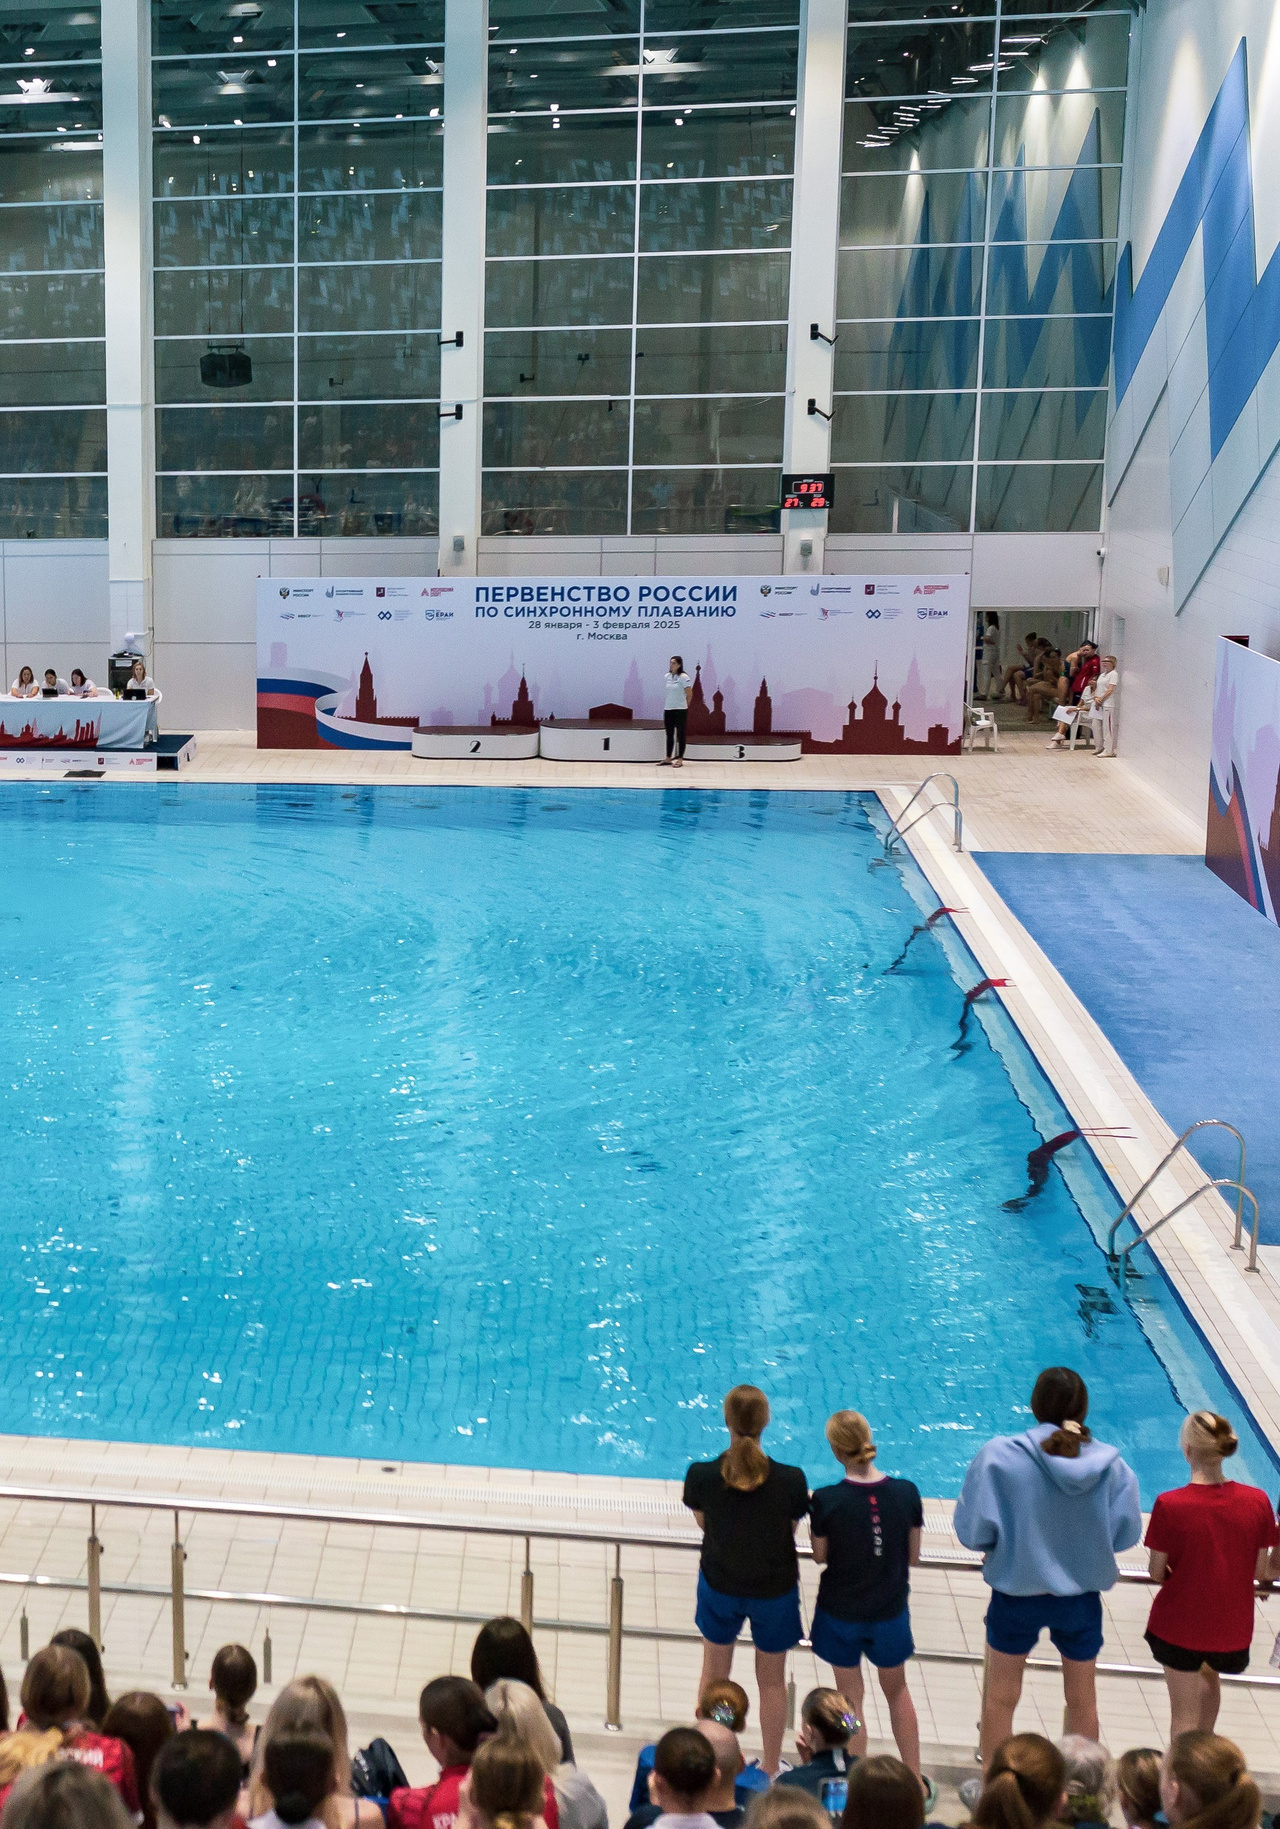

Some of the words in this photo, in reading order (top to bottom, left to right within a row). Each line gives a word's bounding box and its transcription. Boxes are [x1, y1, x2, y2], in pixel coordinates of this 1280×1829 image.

[475, 586, 630, 602] ПЕРВЕНСТВО
[639, 585, 738, 602] РОССИИ
[475, 606, 498, 618] ПО
[504, 606, 632, 618] СИНХРОННОМУ
[638, 606, 736, 618] ПЛАВАНИЮ
[528, 621, 541, 629] 28
[544, 622, 583, 630] января
[593, 621, 599, 629] 3
[602, 621, 650, 630] февраля
[653, 621, 680, 629] 2025
[588, 632, 628, 640] Москва
[469, 740, 481, 754] 2
[601, 737, 610, 752] 1
[733, 746, 745, 759] 3
